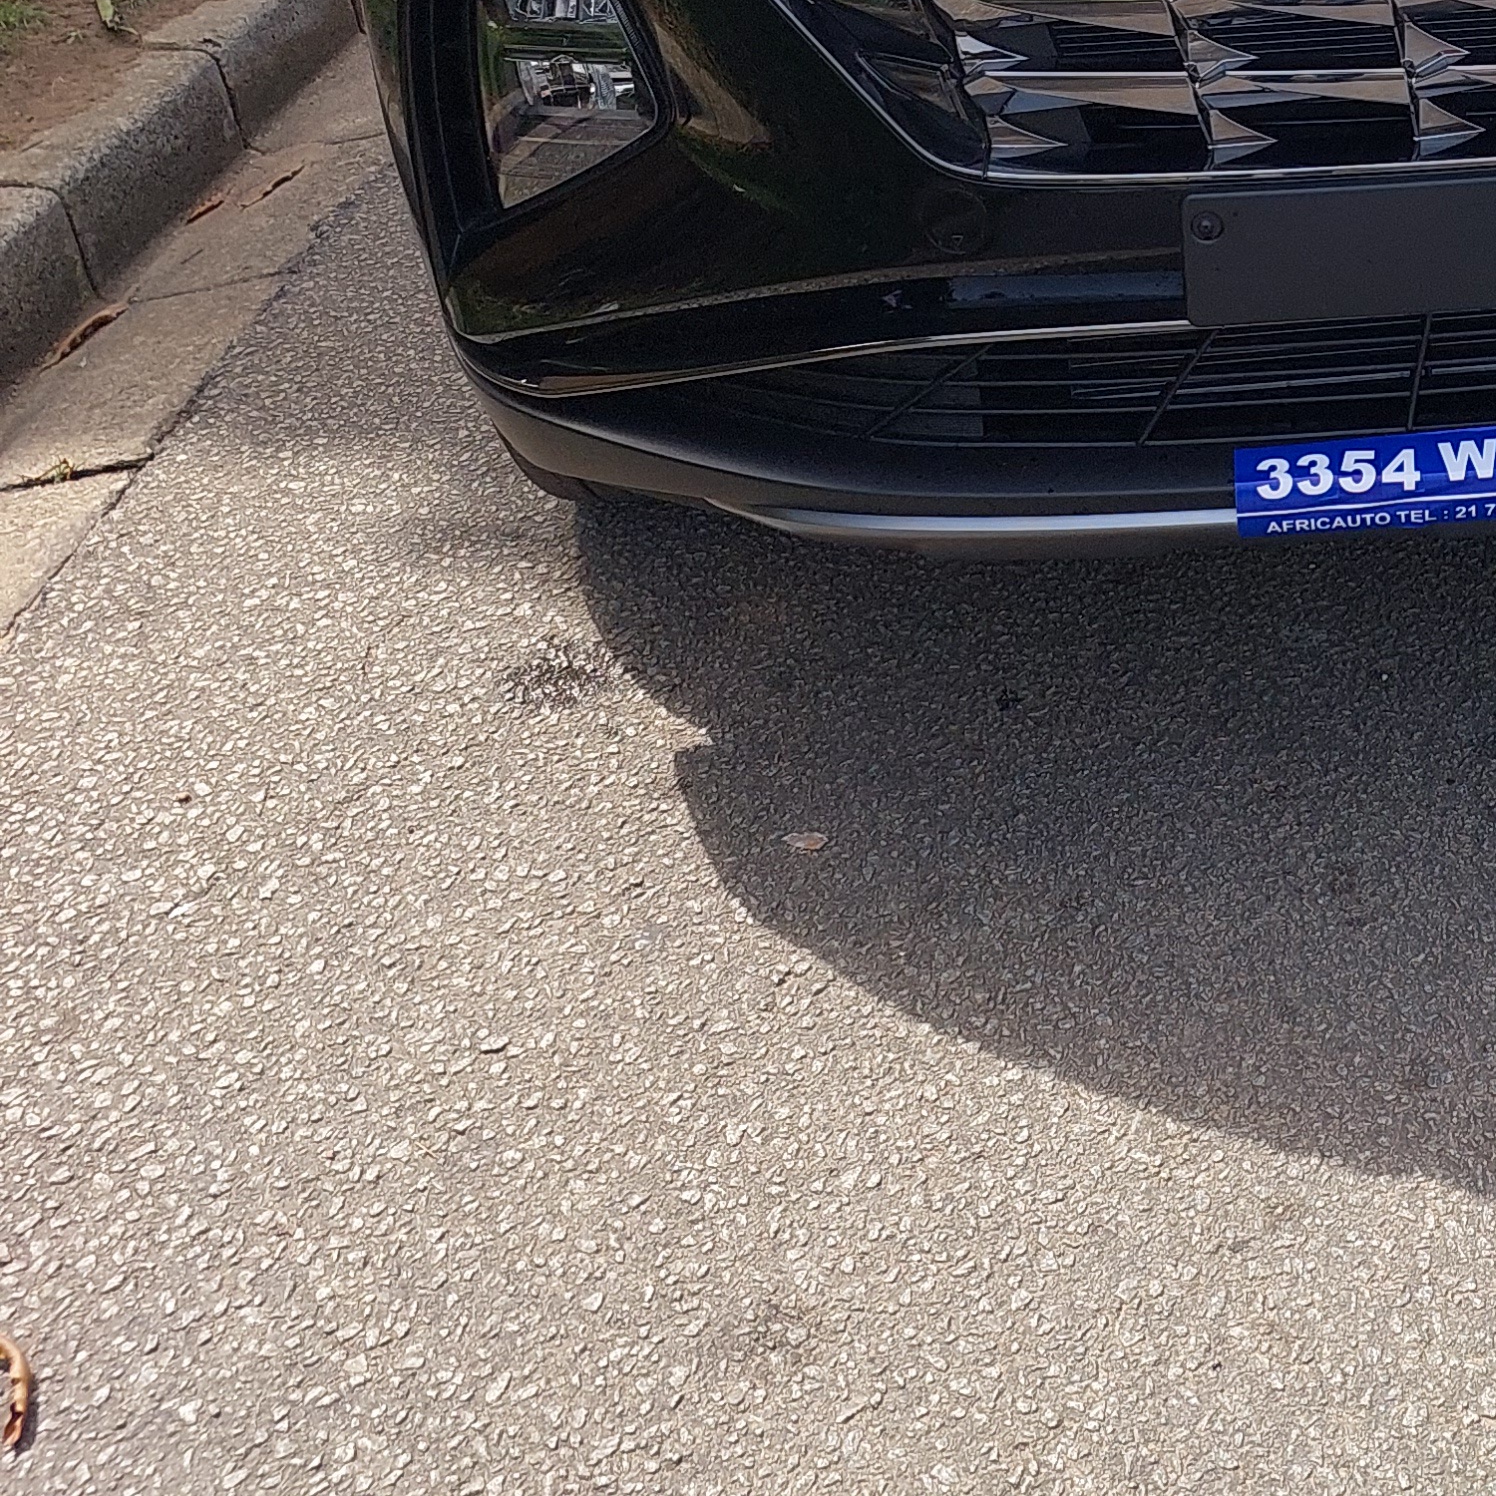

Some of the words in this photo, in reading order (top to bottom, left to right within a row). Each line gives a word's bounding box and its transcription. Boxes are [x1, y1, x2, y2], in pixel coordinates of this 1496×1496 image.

[1255, 447, 1421, 500] 3354
[1266, 511, 1391, 534] AFRICAUTO
[1396, 508, 1437, 523] TEL
[1455, 504, 1477, 519] 21
